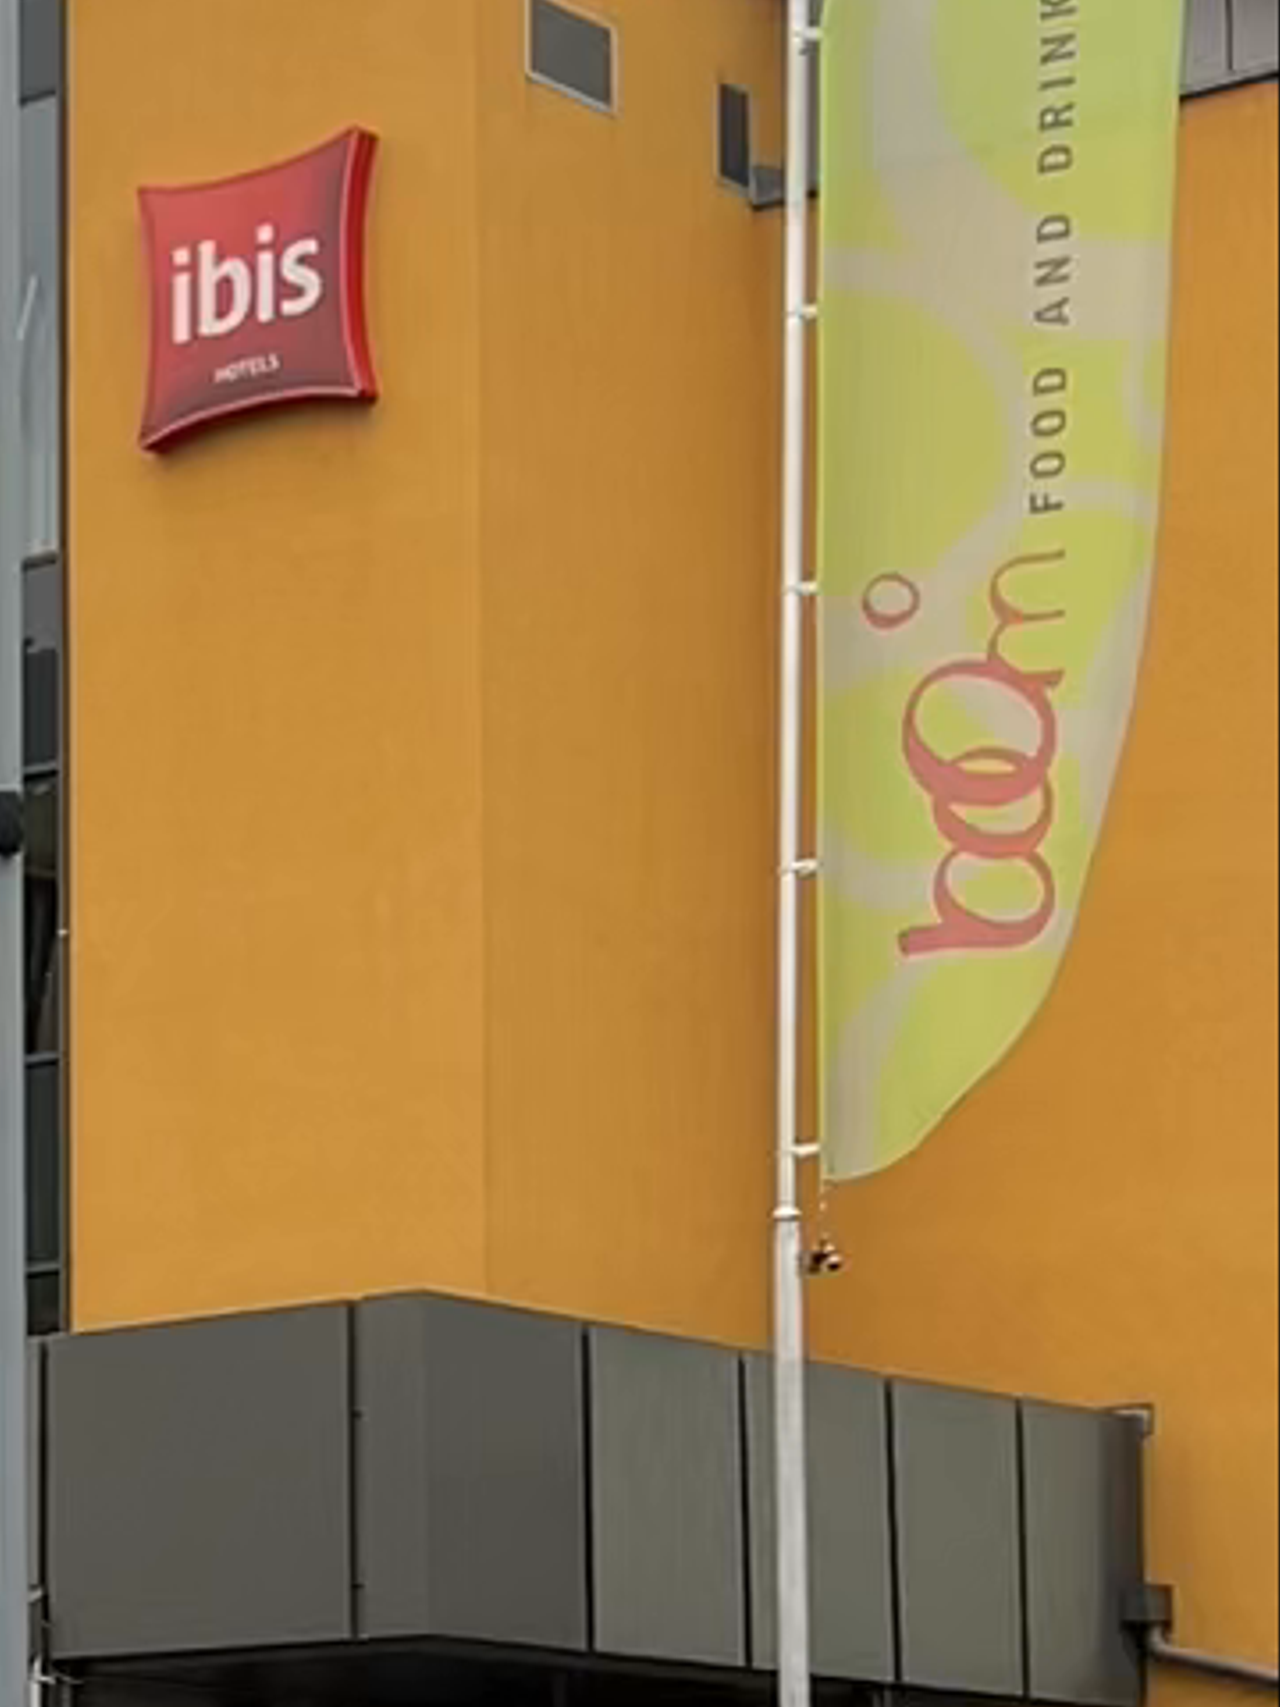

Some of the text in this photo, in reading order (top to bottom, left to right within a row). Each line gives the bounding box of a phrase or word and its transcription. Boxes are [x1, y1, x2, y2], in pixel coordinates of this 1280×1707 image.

[172, 222, 323, 345] ibis
[1034, 214, 1073, 329] AND
[214, 353, 281, 384] HOTELS
[1030, 364, 1068, 516] FOOD
